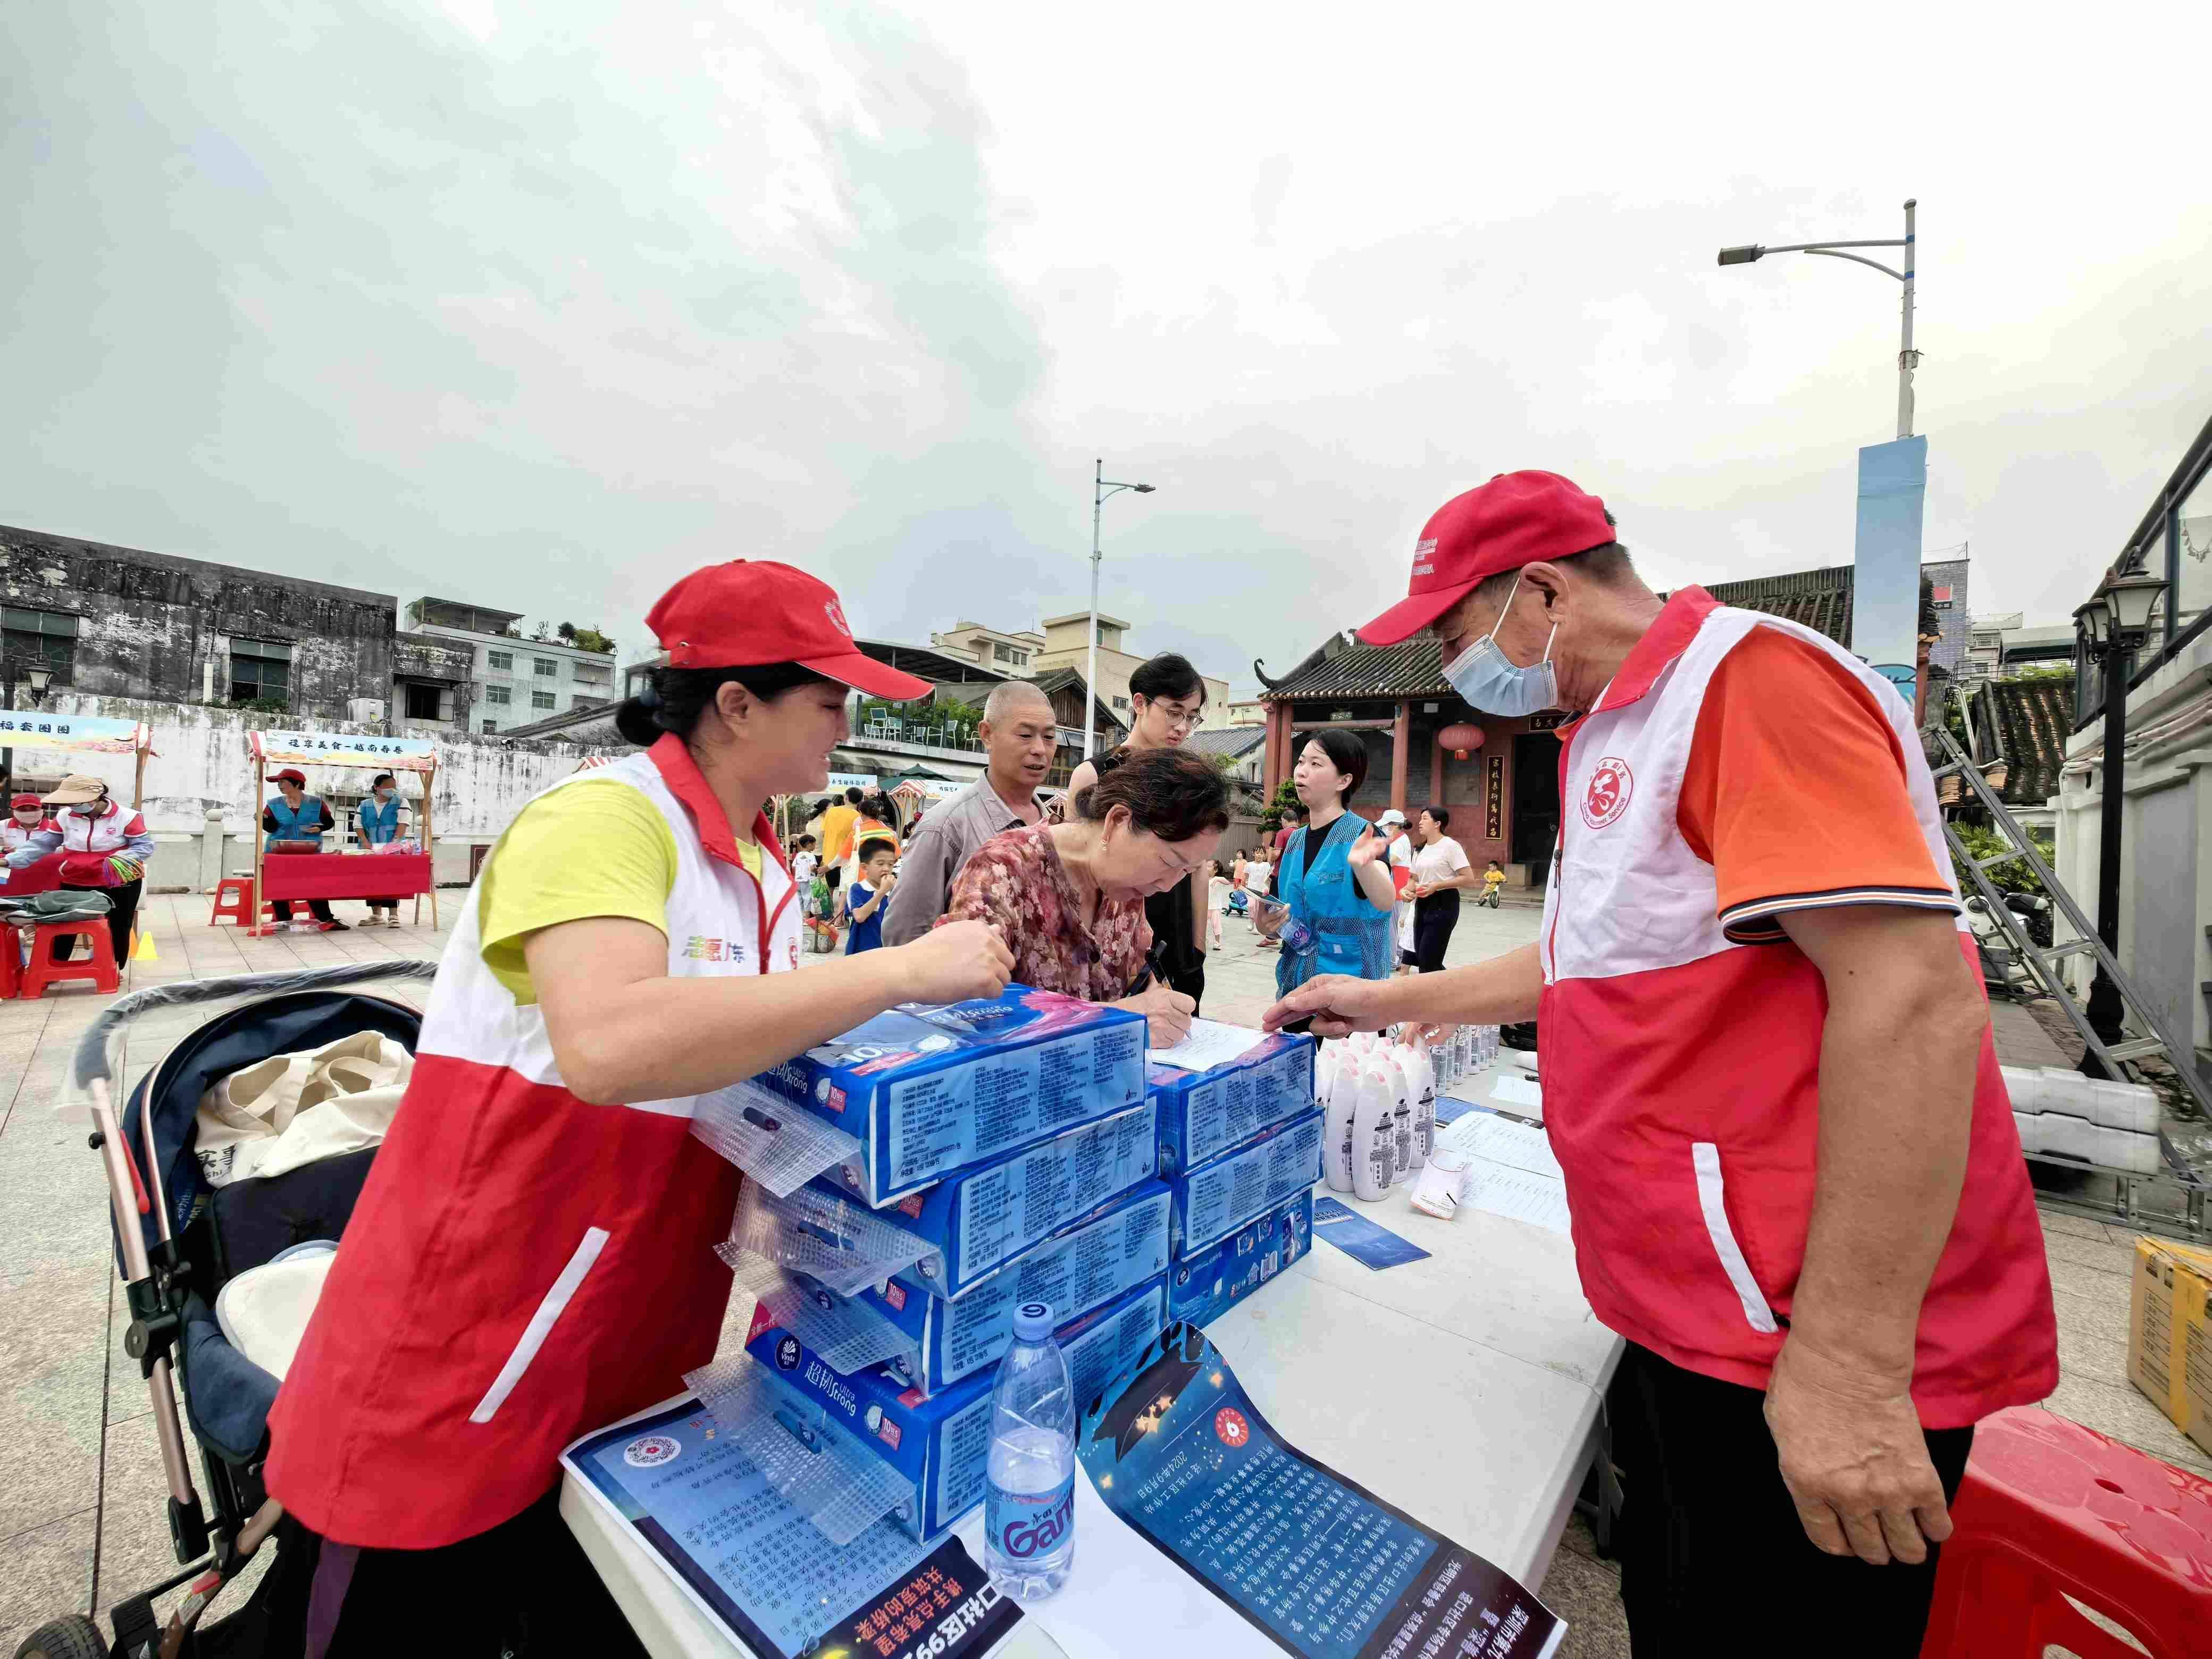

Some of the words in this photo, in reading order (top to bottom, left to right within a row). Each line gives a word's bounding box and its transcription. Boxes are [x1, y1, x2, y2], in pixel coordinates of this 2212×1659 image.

[781, 1352, 795, 1362] Vinda
[830, 1381, 857, 1417] Strong
[840, 1384, 856, 1401] Ultra
[1135, 1451, 1188, 1499] 2024年9月9日
[852, 1564, 944, 1643] 共筑爱的桥梁
[872, 1576, 965, 1658] 携手点亮希望
[902, 1579, 1003, 1659] 口社区99
